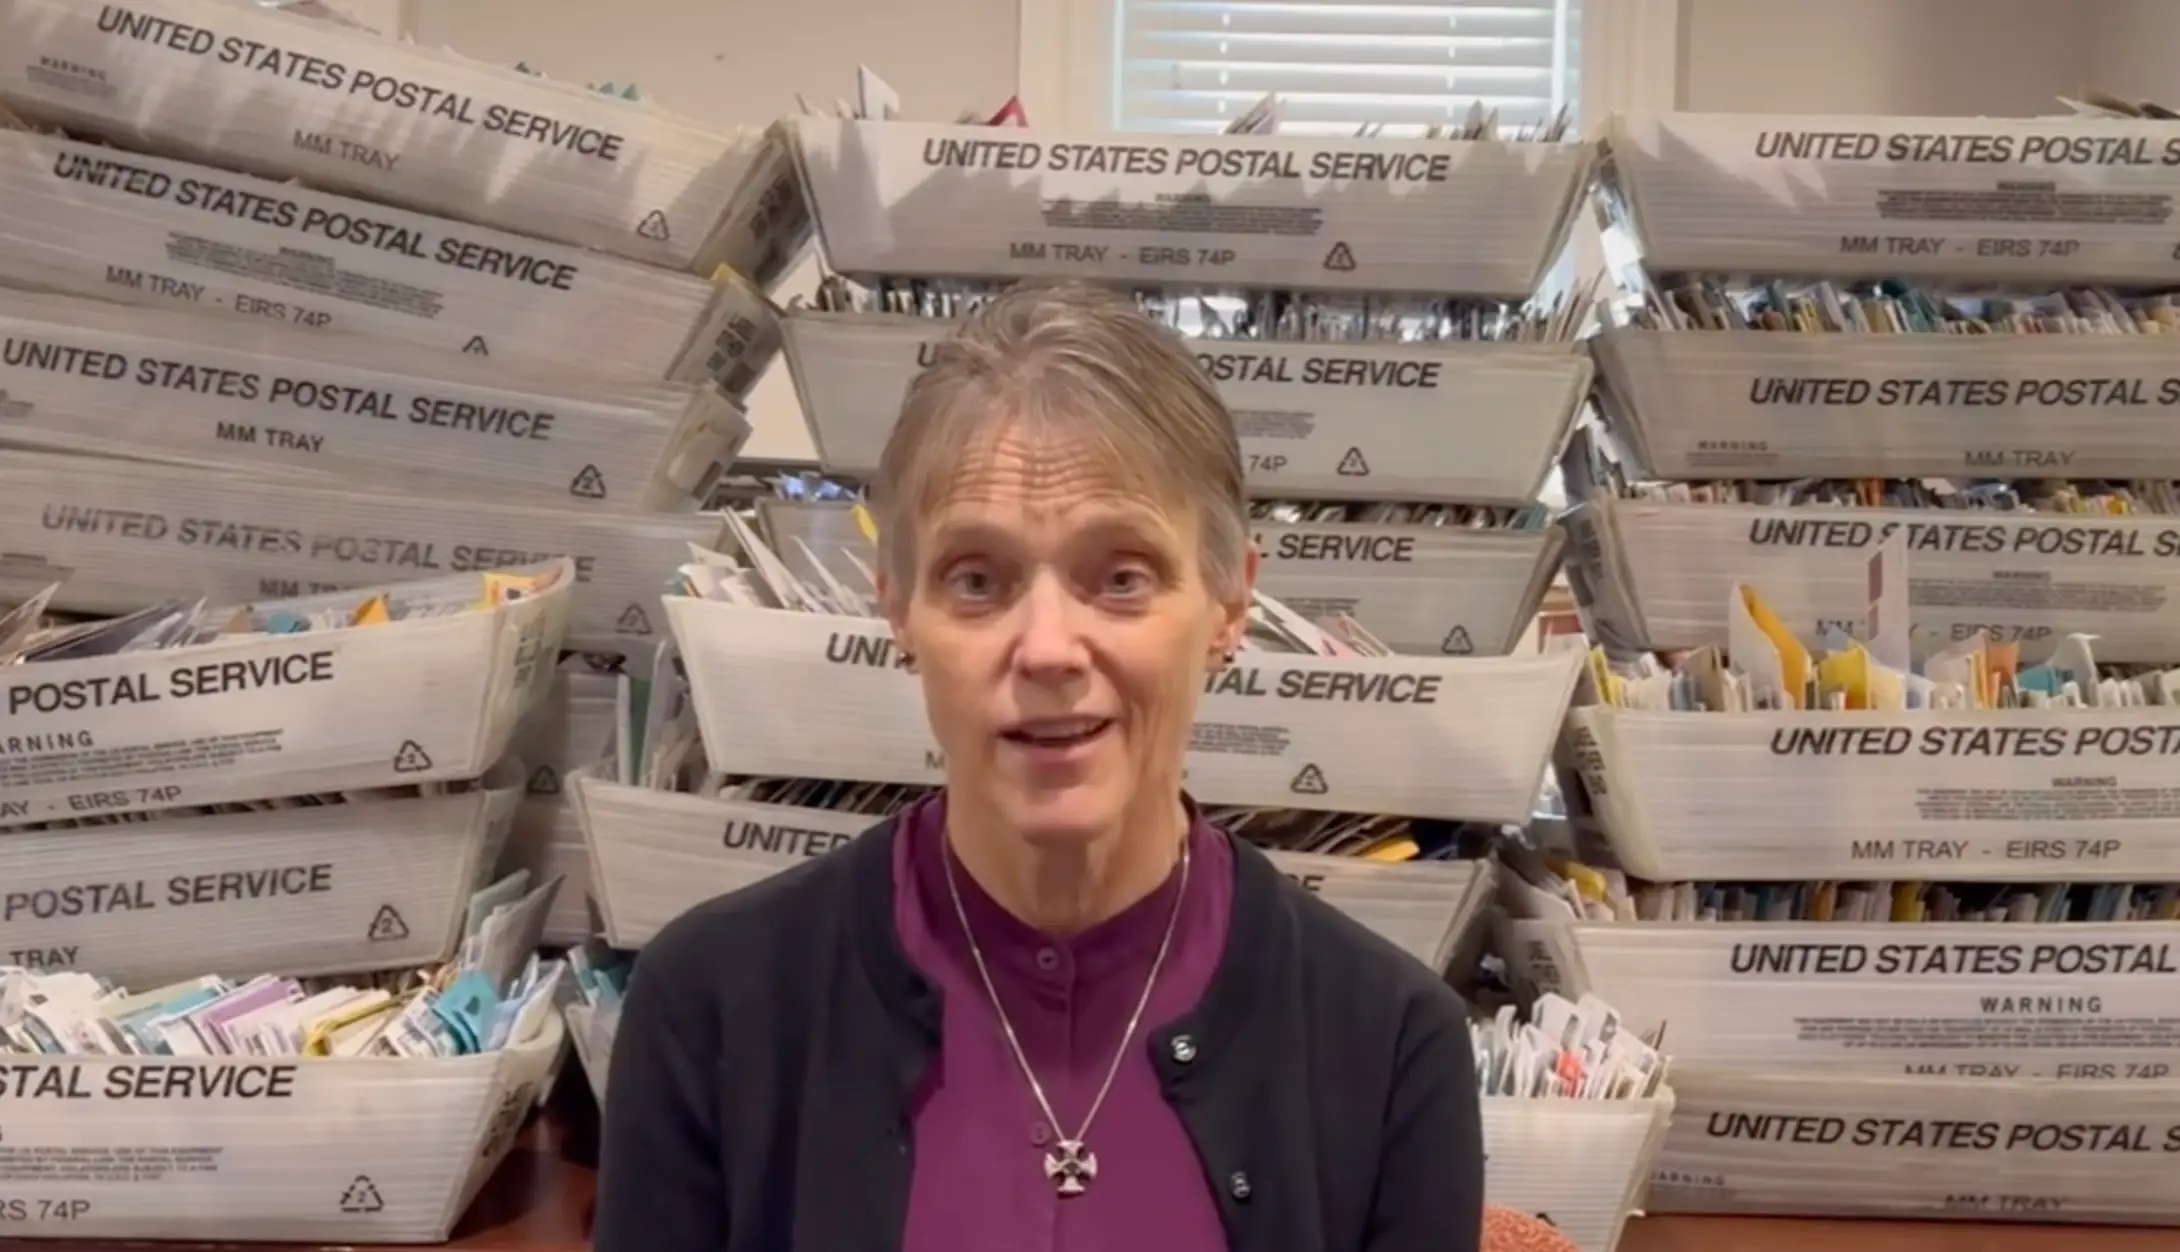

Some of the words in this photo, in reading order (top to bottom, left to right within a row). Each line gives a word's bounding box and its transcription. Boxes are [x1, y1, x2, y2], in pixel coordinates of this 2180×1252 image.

[97, 6, 214, 56] UNITED
[218, 36, 347, 90] STATES
[348, 69, 476, 125] POSTAL
[483, 105, 625, 163] SERVICE
[293, 129, 330, 153] MM
[337, 138, 400, 172] TRAY
[922, 138, 1041, 170] UNITED
[1047, 144, 1169, 175] STATES
[1175, 148, 1303, 181] POSTAL
[1309, 152, 1451, 184] SERVICE
[1755, 131, 1881, 160] UNITED
[1885, 133, 2013, 163] STATES
[2019, 135, 2153, 165] POSTAL
[52, 151, 171, 200] UNITED
[175, 179, 298, 229] STATES
[301, 206, 430, 259] POSTAL
[435, 237, 579, 292] SERVICE
[1009, 242, 1047, 261] MM
[1051, 243, 1110, 263] TRAY
[1139, 247, 1191, 267] EIRS
[1197, 249, 1236, 267] 74P
[1840, 236, 1879, 254] MM
[1885, 236, 1946, 256] TRAY
[1976, 238, 2032, 257] EIRS
[2037, 240, 2080, 257] 74P
[105, 265, 143, 290] MM
[147, 274, 205, 302] TRAY
[235, 294, 287, 321] EIRS
[293, 303, 333, 328] 74P
[1196, 353, 1294, 383] OSTAL
[1301, 357, 1443, 389] SERVICE
[3, 337, 127, 381] UNITED
[134, 357, 260, 400] STATES
[268, 376, 399, 421] POSTAL
[408, 397, 555, 442] SERVICE
[1749, 377, 1870, 405] UNITED
[1877, 380, 2010, 407] STATES
[2014, 379, 2148, 407] POSTAL
[215, 420, 259, 447] MM
[265, 427, 326, 455] TRAY
[1247, 454, 1288, 473] 74P
[2012, 450, 2077, 468] TRAY
[41, 503, 169, 541] UNITED
[177, 518, 303, 557] STATES
[311, 533, 441, 570] POSTAL
[1277, 534, 1416, 562] SERVICE
[1749, 518, 1872, 547] UNITED
[2013, 526, 2146, 557] POSTAL
[258, 578, 299, 597] MM
[2010, 625, 2054, 642] 74P
[8, 673, 161, 715] POSTAL
[169, 650, 335, 699] SERVICE
[1276, 669, 1443, 704] SERVICE
[1769, 727, 1913, 755] UNITED
[1918, 728, 2066, 756] STATES
[2072, 726, 2180, 756] POST
[67, 790, 131, 813] EIRS
[136, 784, 183, 804] 74P
[1852, 840, 1894, 860] MM
[1902, 840, 1970, 860] TRAY
[2005, 839, 2066, 860] EIRS
[2073, 840, 2121, 860] 74P
[3, 885, 158, 921] POSTAL
[167, 863, 334, 908] SERVICE
[8, 946, 80, 969] TRAY
[1731, 944, 1867, 974] UNITED
[1873, 944, 2023, 974] STATES
[2029, 944, 2177, 974] POSTAL
[1979, 996, 2103, 1014] WARNING
[0, 1065, 92, 1099] TAL
[103, 1064, 297, 1100] SERVICE
[1955, 1063, 2021, 1078] TRAY
[2123, 1063, 2170, 1080] 74P
[1706, 1111, 1847, 1145] UNITED
[1851, 1119, 1999, 1149] STATES
[2005, 1123, 2152, 1152] POSTAL
[38, 1198, 91, 1221] 74P
